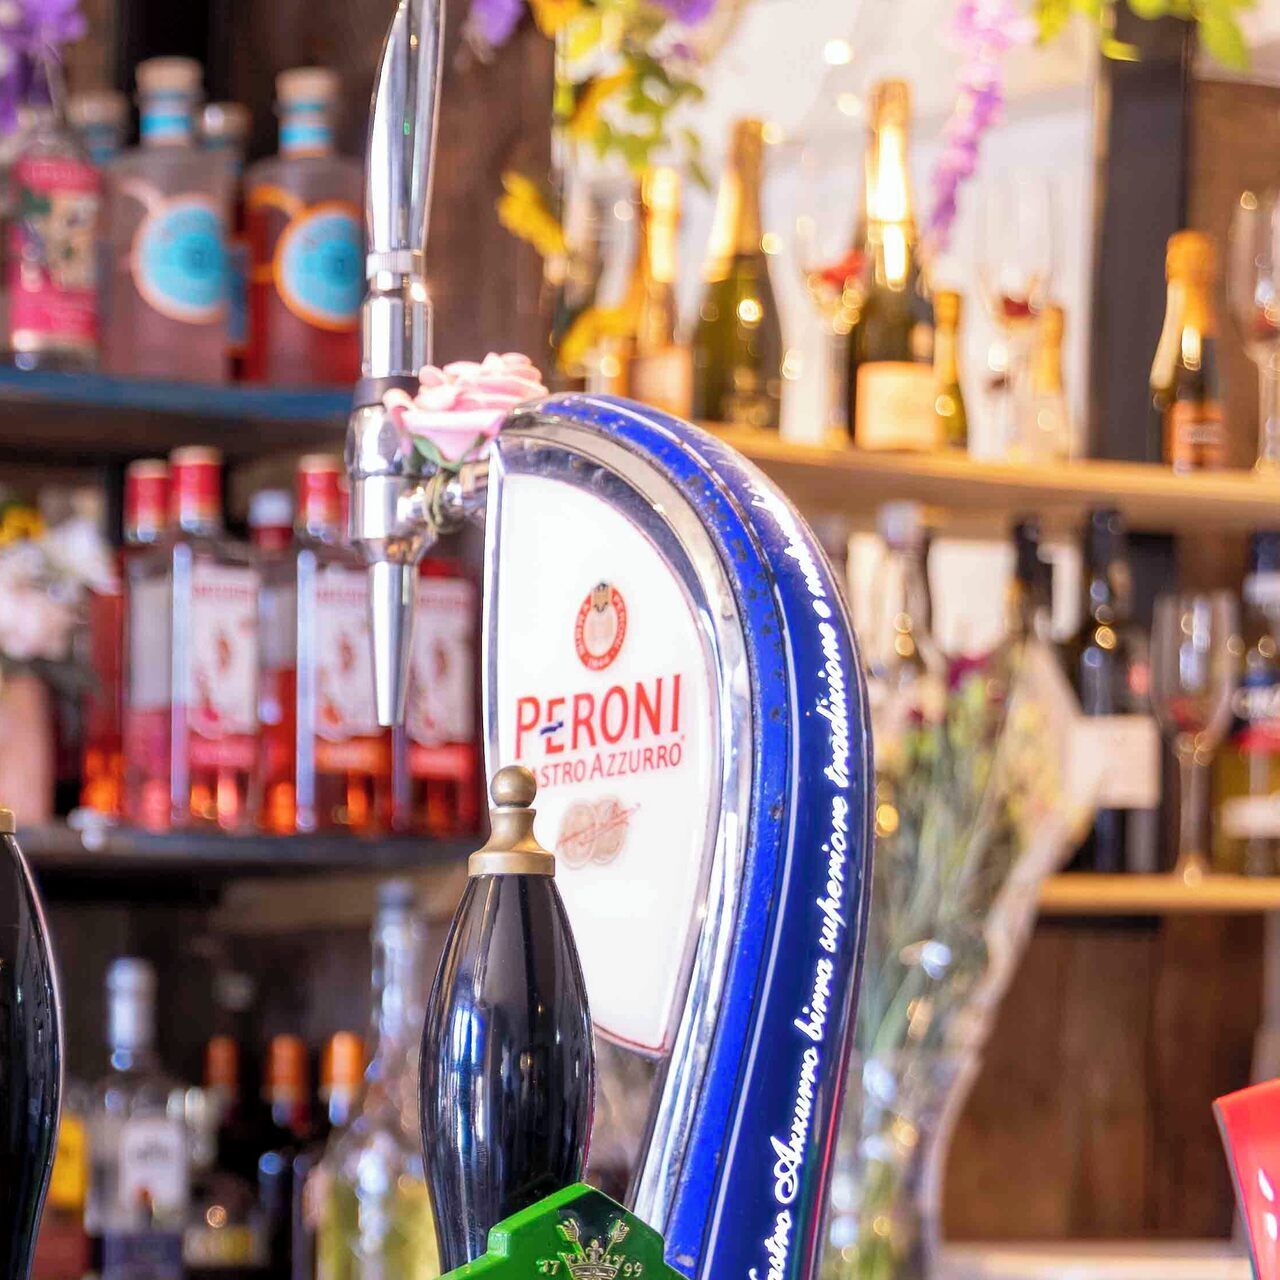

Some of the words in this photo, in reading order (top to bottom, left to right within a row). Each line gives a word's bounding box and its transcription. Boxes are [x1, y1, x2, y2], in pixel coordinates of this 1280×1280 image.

[514, 674, 681, 760] PERONI
[590, 741, 682, 781] AZZURRO
[816, 795, 849, 953] superiore
